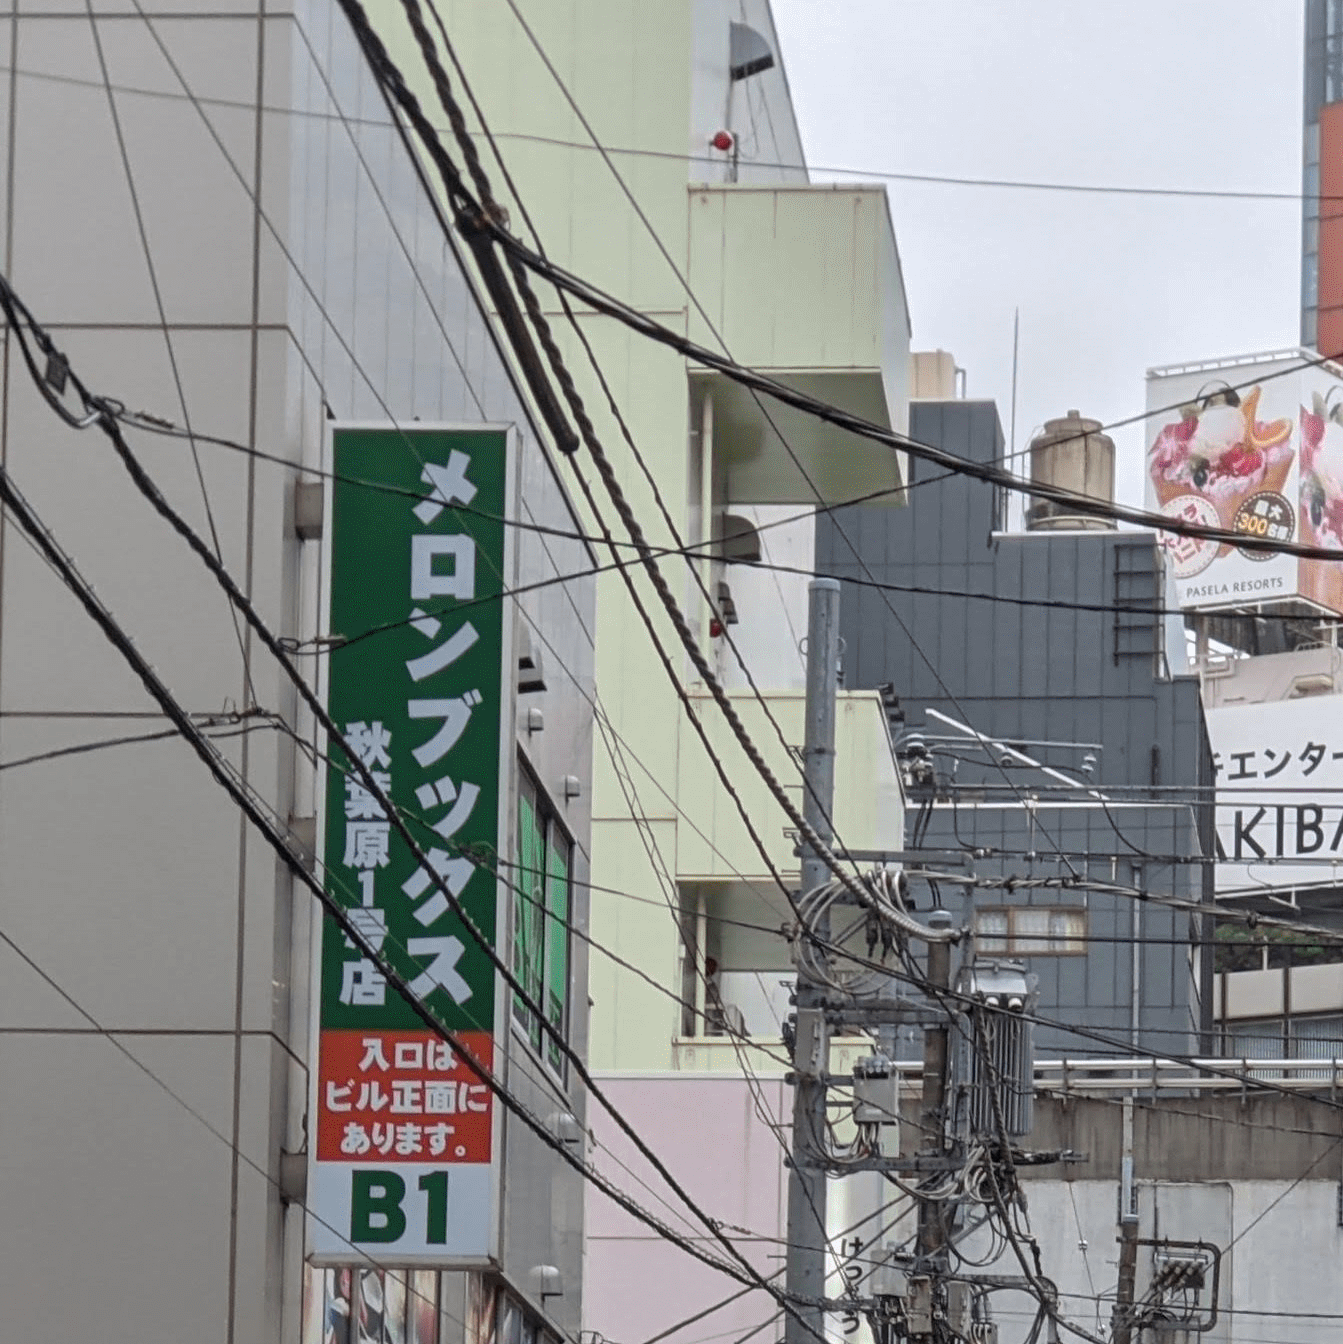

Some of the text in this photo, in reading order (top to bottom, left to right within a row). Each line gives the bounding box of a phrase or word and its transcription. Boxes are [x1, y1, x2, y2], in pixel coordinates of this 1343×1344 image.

[1185, 577, 1284, 599] PASELA RESORTS
[402, 447, 479, 1005] メロンブックス
[339, 720, 392, 1007] 秋葉原1号店
[359, 1037, 456, 1073] 入口は
[325, 1079, 490, 1114] ビル正面に
[341, 1122, 470, 1157] あります。
[351, 1170, 450, 1245] B1
